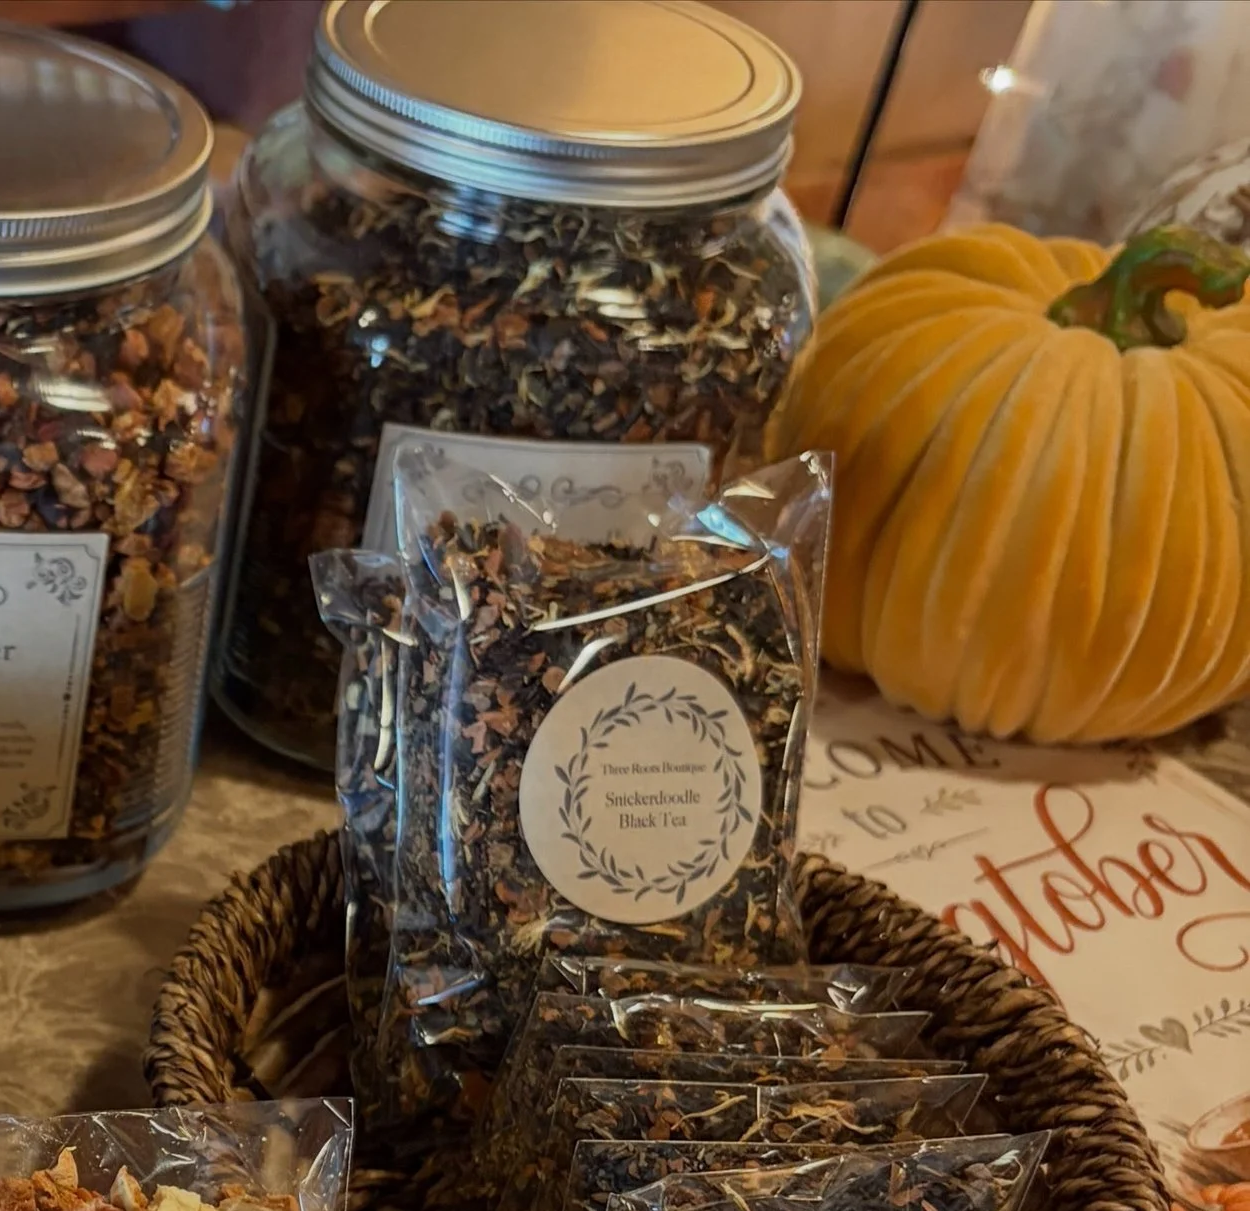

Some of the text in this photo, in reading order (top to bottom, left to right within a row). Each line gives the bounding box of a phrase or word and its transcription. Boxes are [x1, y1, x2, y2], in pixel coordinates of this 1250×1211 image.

[602, 762, 707, 777] Three Roots Boutique
[605, 790, 701, 808] Snickerdoodle
[618, 812, 687, 830] Black Tea
[840, 804, 908, 840] to
